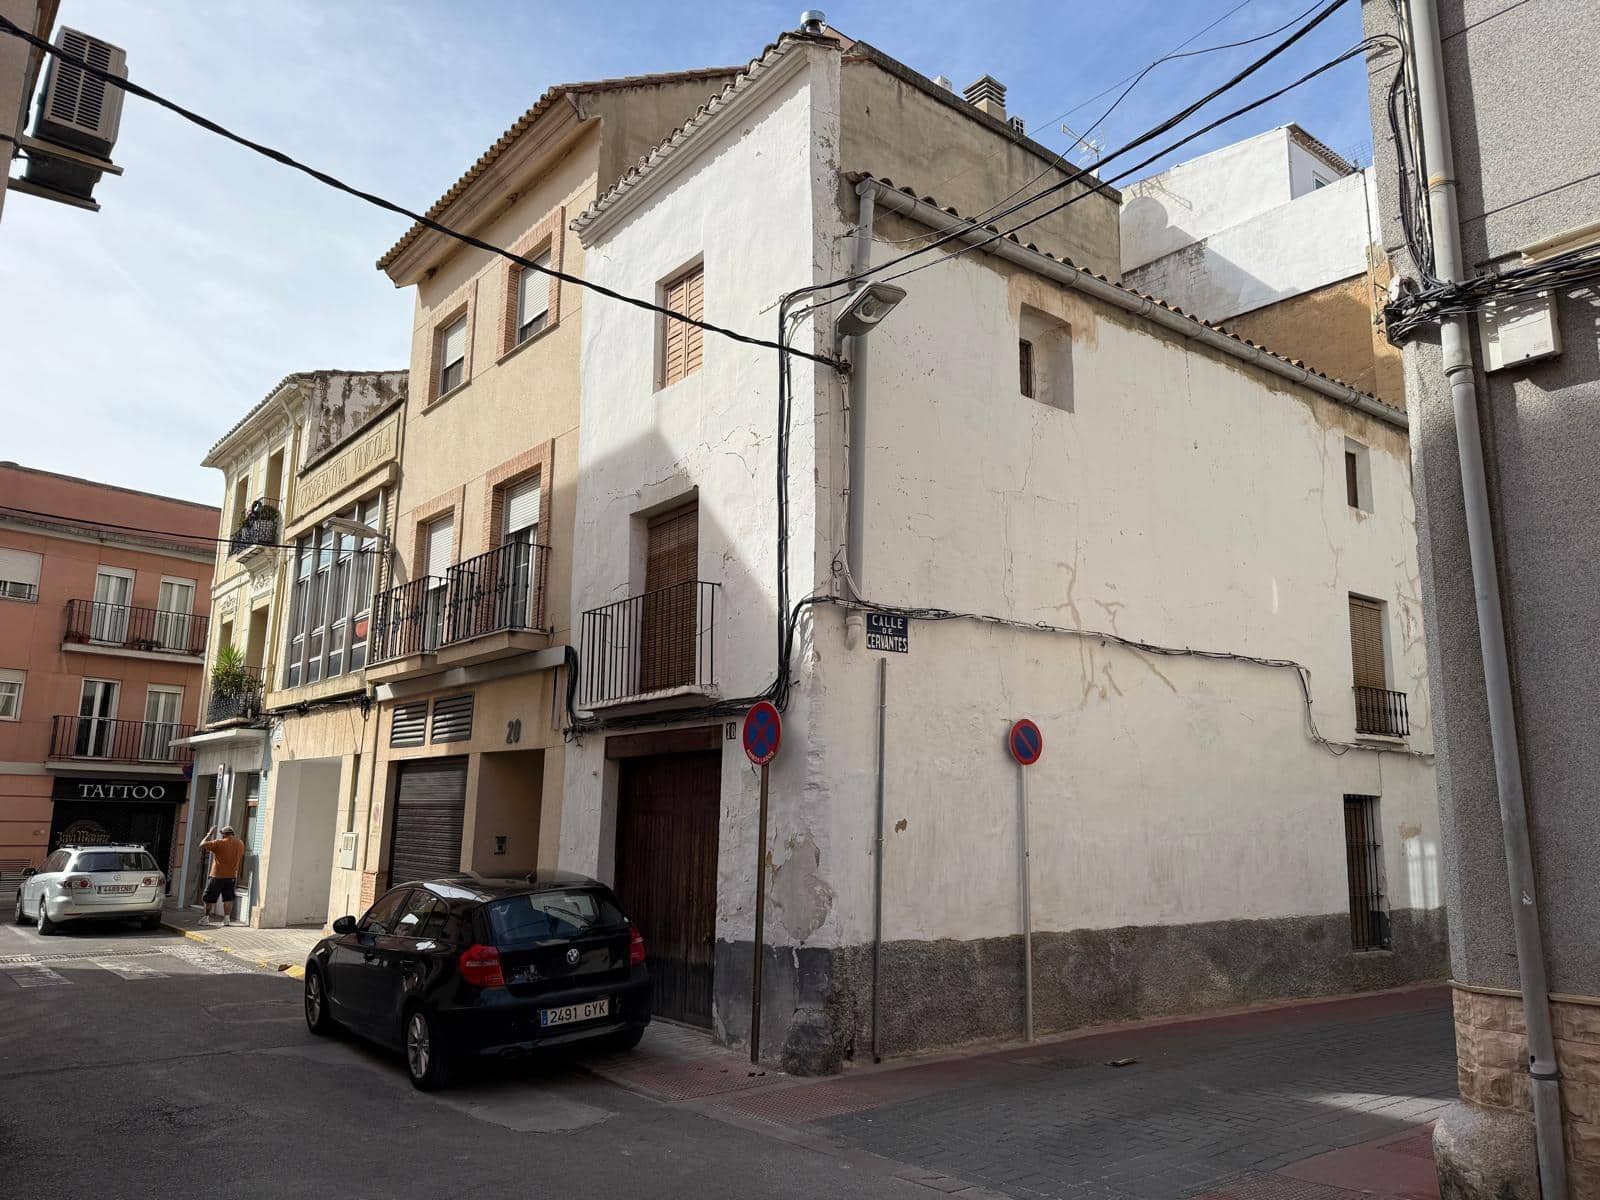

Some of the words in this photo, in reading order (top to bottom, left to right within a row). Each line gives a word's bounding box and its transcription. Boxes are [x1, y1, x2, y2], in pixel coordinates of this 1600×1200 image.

[872, 614, 903, 629] CALLE
[882, 627, 893, 635] DE
[867, 633, 908, 652] CERVANTES
[505, 718, 521, 744] 20
[79, 784, 165, 799] TATTOO
[550, 1007, 577, 1024] 2491
[584, 1001, 606, 1017] GYK
